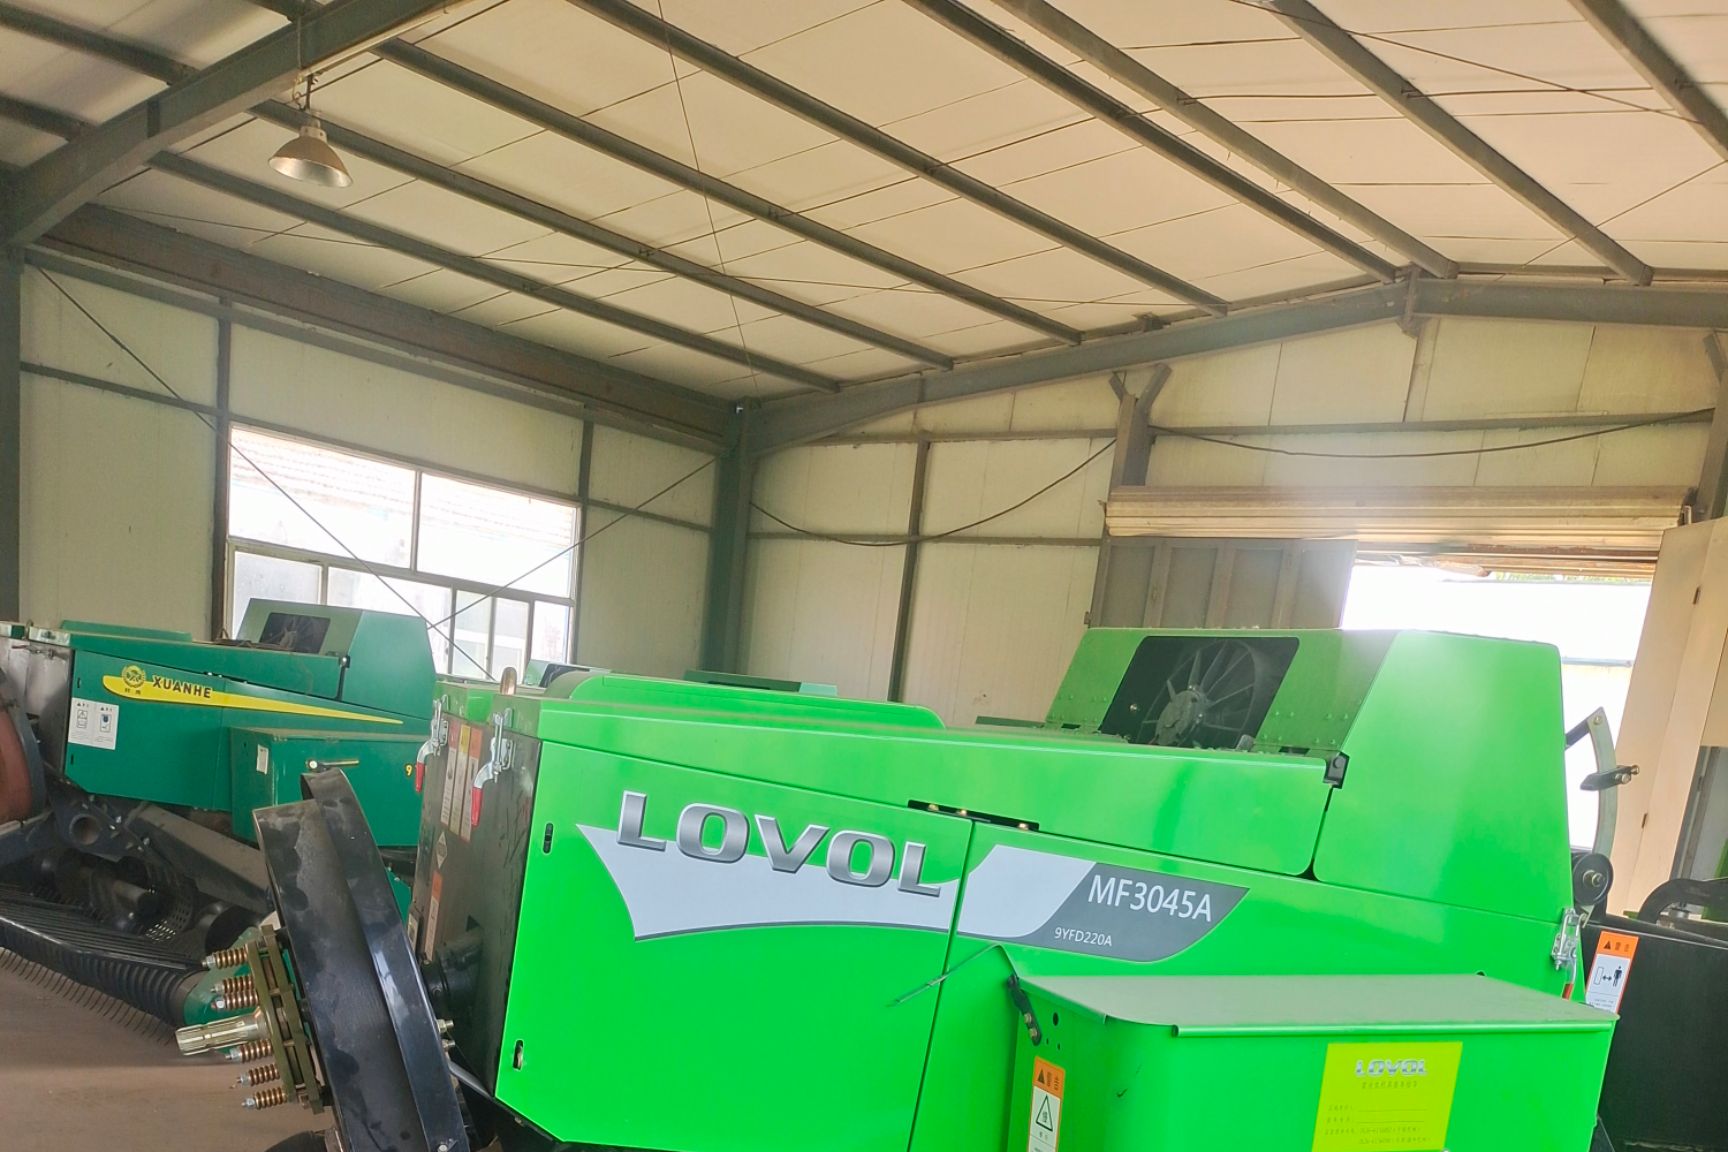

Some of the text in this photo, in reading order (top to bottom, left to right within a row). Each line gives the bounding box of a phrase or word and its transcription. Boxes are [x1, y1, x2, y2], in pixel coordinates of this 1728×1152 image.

[153, 675, 212, 699] XUANHE
[617, 790, 941, 897] LOVOL
[1088, 874, 1212, 922] MF3045A
[1054, 926, 1112, 946] 9YFD220A
[1355, 1058, 1428, 1077] LOVOL
